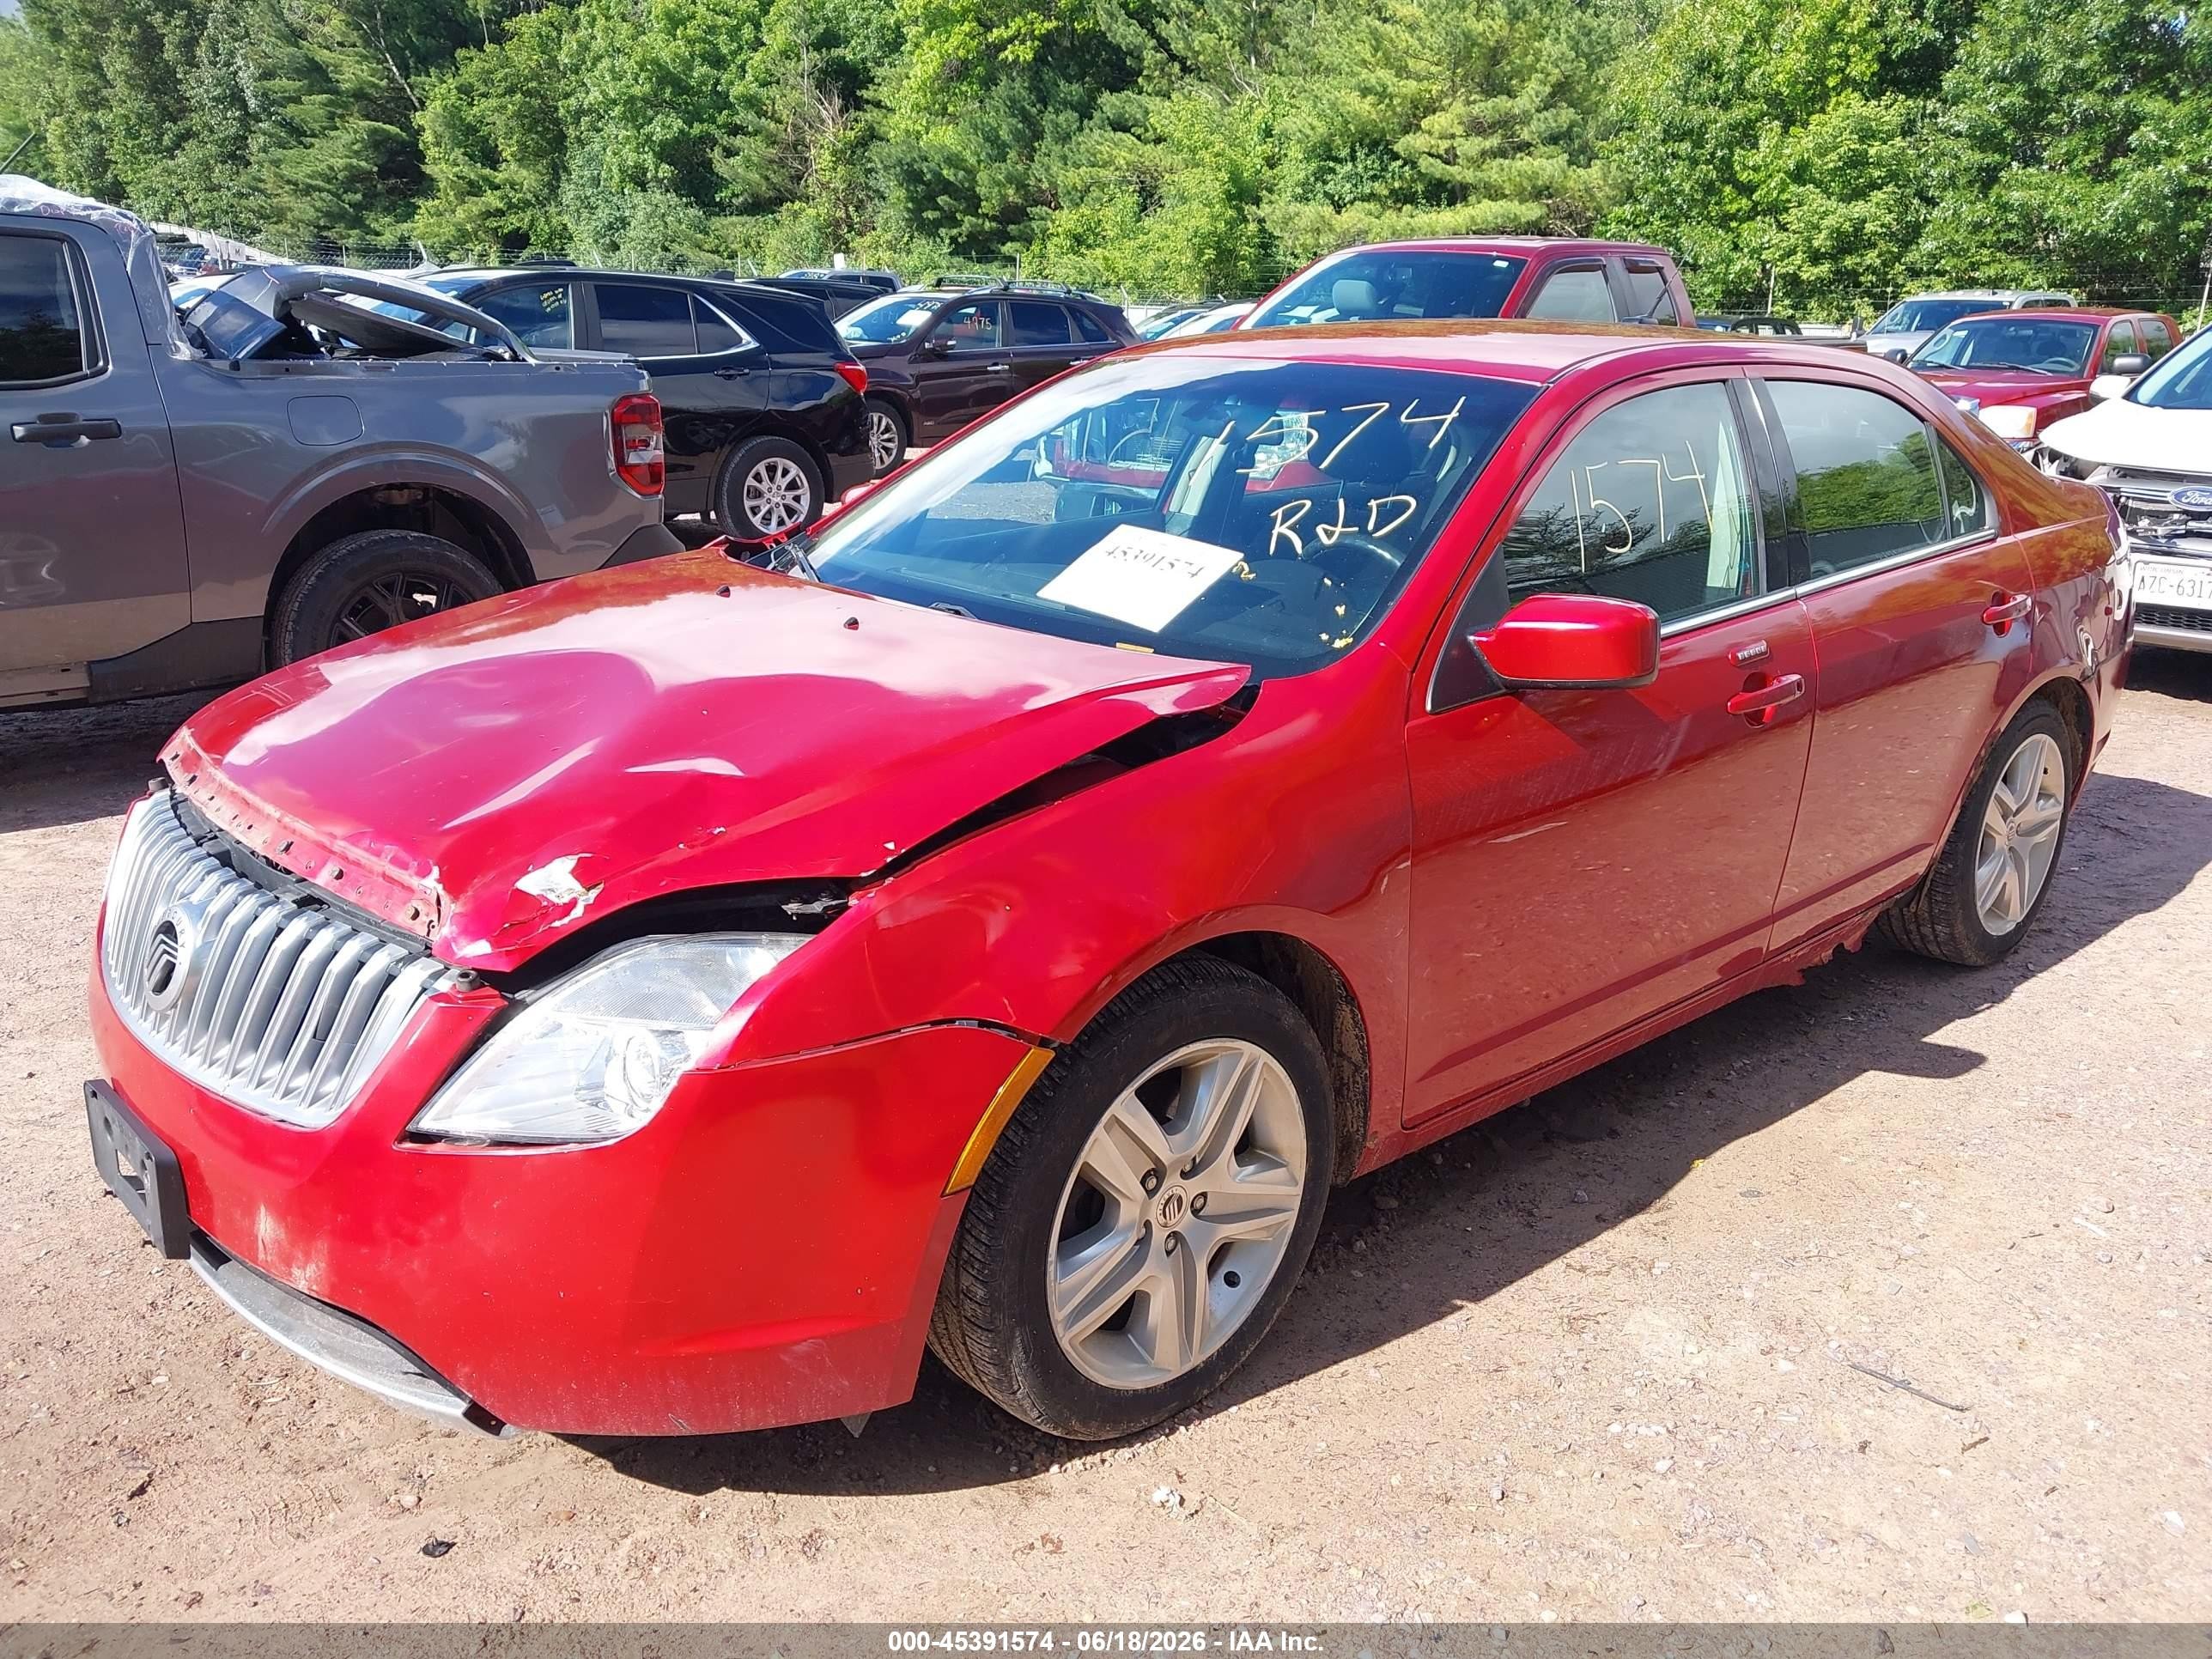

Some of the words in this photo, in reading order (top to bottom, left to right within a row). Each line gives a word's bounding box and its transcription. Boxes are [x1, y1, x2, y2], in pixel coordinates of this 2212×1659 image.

[963, 316, 993, 331] 4975
[1188, 395, 1467, 487] 1574
[1570, 440, 1716, 574] 1574
[155, 907, 186, 949] RCURY
